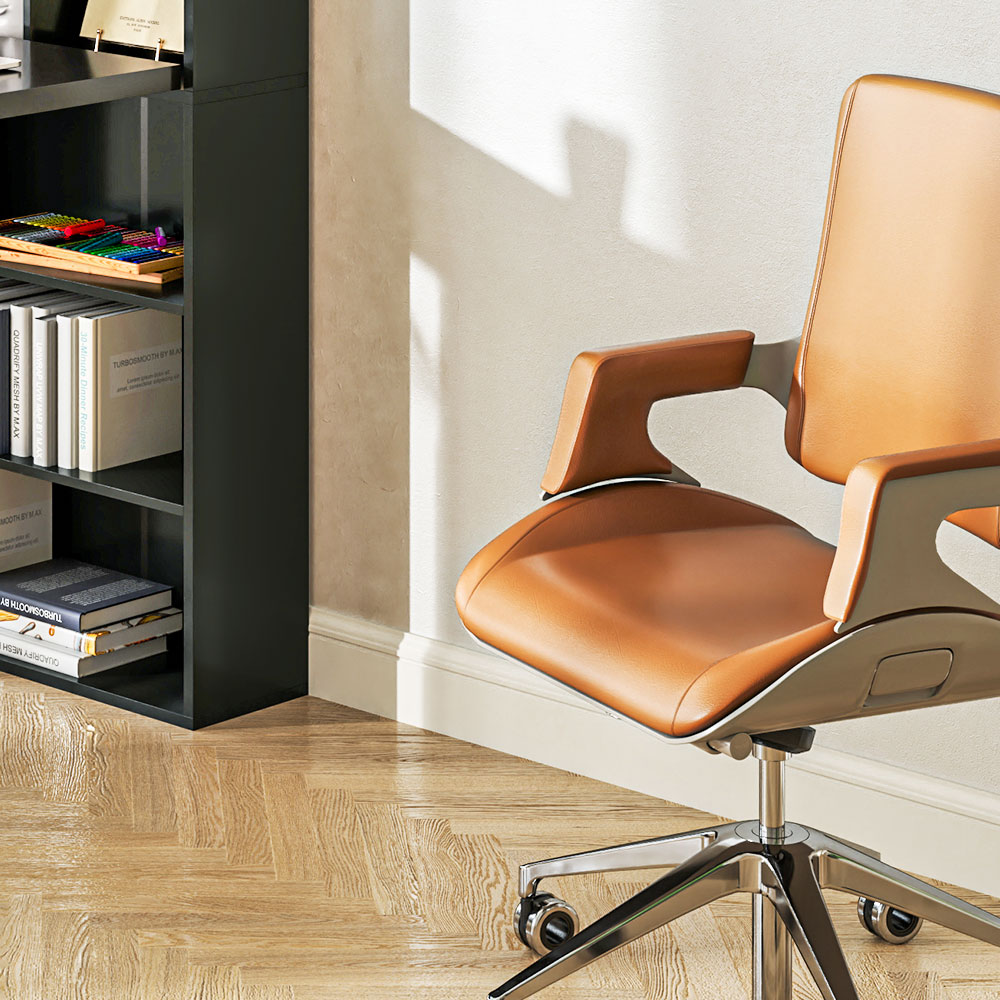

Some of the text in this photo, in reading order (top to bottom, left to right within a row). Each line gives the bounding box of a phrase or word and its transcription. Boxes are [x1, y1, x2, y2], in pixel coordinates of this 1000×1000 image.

[13, 329, 21, 375] QUADRIFY
[113, 353, 160, 368] TURBOSMOOTH
[160, 350, 169, 359] BY
[13, 375, 21, 402] MESH
[80, 331, 88, 450] 30-Minute Dinner Recipes
[13, 403, 21, 416] BY
[0, 596, 10, 608] BY
[10, 600, 62, 623] TURBOSMOOTH
[2, 643, 23, 656] MESH
[23, 649, 60, 667] QUADRIFY
